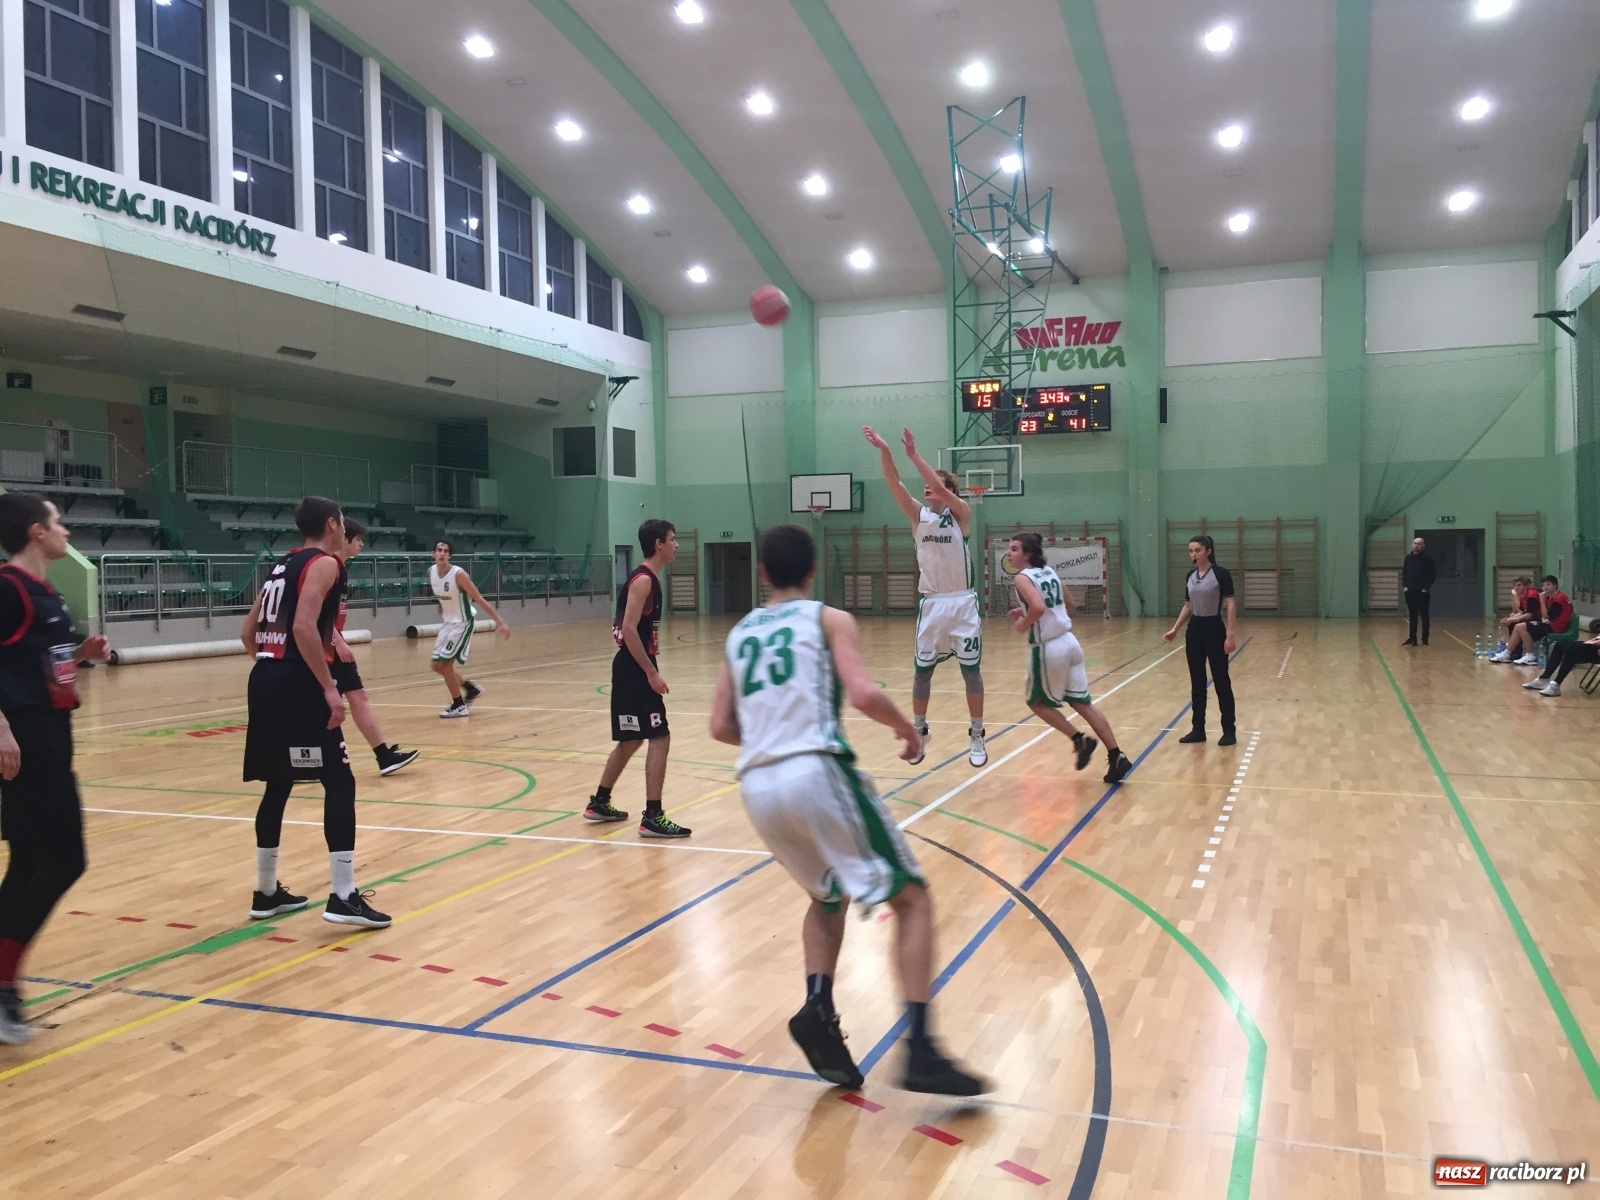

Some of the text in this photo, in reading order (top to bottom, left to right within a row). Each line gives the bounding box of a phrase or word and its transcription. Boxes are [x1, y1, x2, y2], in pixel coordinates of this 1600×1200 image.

[12, 155, 20, 184] I
[30, 161, 166, 225] REKREACJI
[174, 205, 277, 258] RACIBÓRZ
[977, 394, 992, 408] 15
[1020, 420, 1037, 432] 23
[1069, 418, 1086, 429] 41
[443, 581, 450, 592] 6
[1041, 578, 1062, 608] 32
[446, 641, 454, 651] 6
[963, 636, 980, 653] 24
[737, 627, 794, 697] 23
